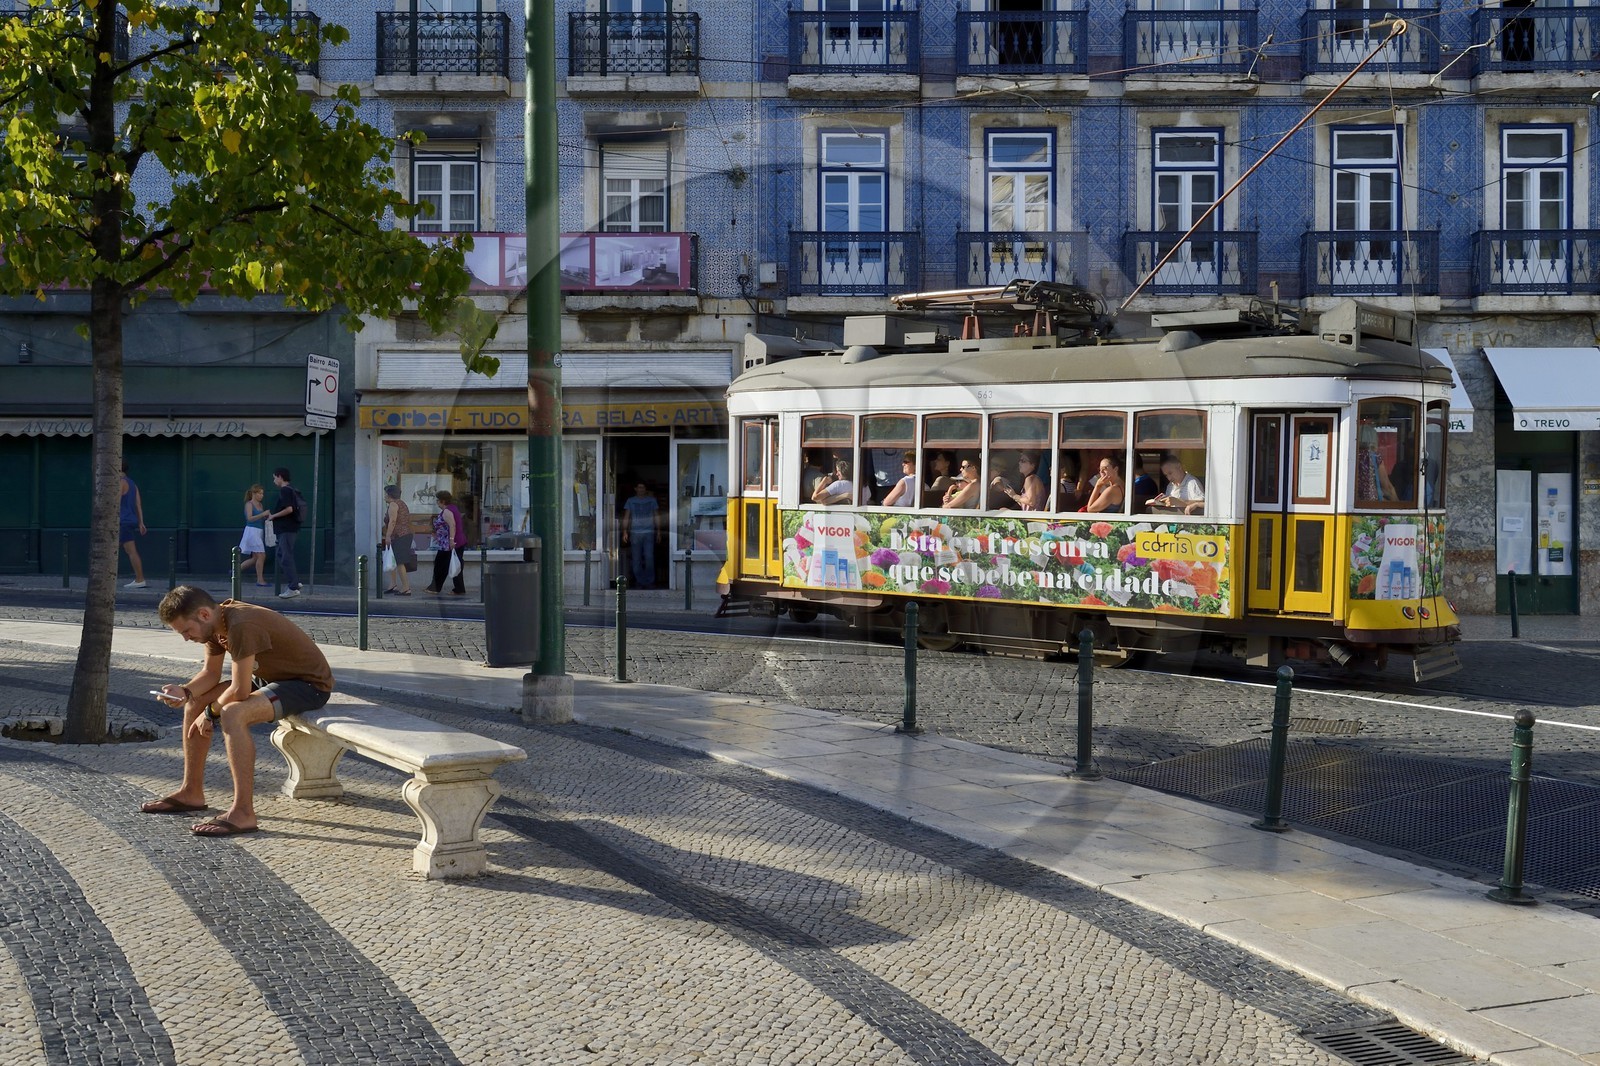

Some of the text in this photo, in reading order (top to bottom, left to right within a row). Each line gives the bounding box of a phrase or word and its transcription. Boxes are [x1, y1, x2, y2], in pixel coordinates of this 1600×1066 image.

[309, 356, 339, 368] Bairro Alto
[977, 390, 993, 399] 563
[372, 409, 447, 426] Corbel
[468, 412, 520, 426] TUDO
[597, 409, 657, 426] BELAS
[1520, 419, 1570, 428] O TREVO
[132, 422, 151, 434] DA
[818, 526, 851, 537] VIGOR
[890, 528, 943, 552] Esta
[987, 532, 1110, 559] frescura
[1142, 536, 1188, 554] carris
[1387, 537, 1415, 546] VIGOR
[889, 564, 934, 585] que
[938, 565, 965, 584] se
[970, 562, 1032, 588] bebe
[1037, 571, 1072, 589] na
